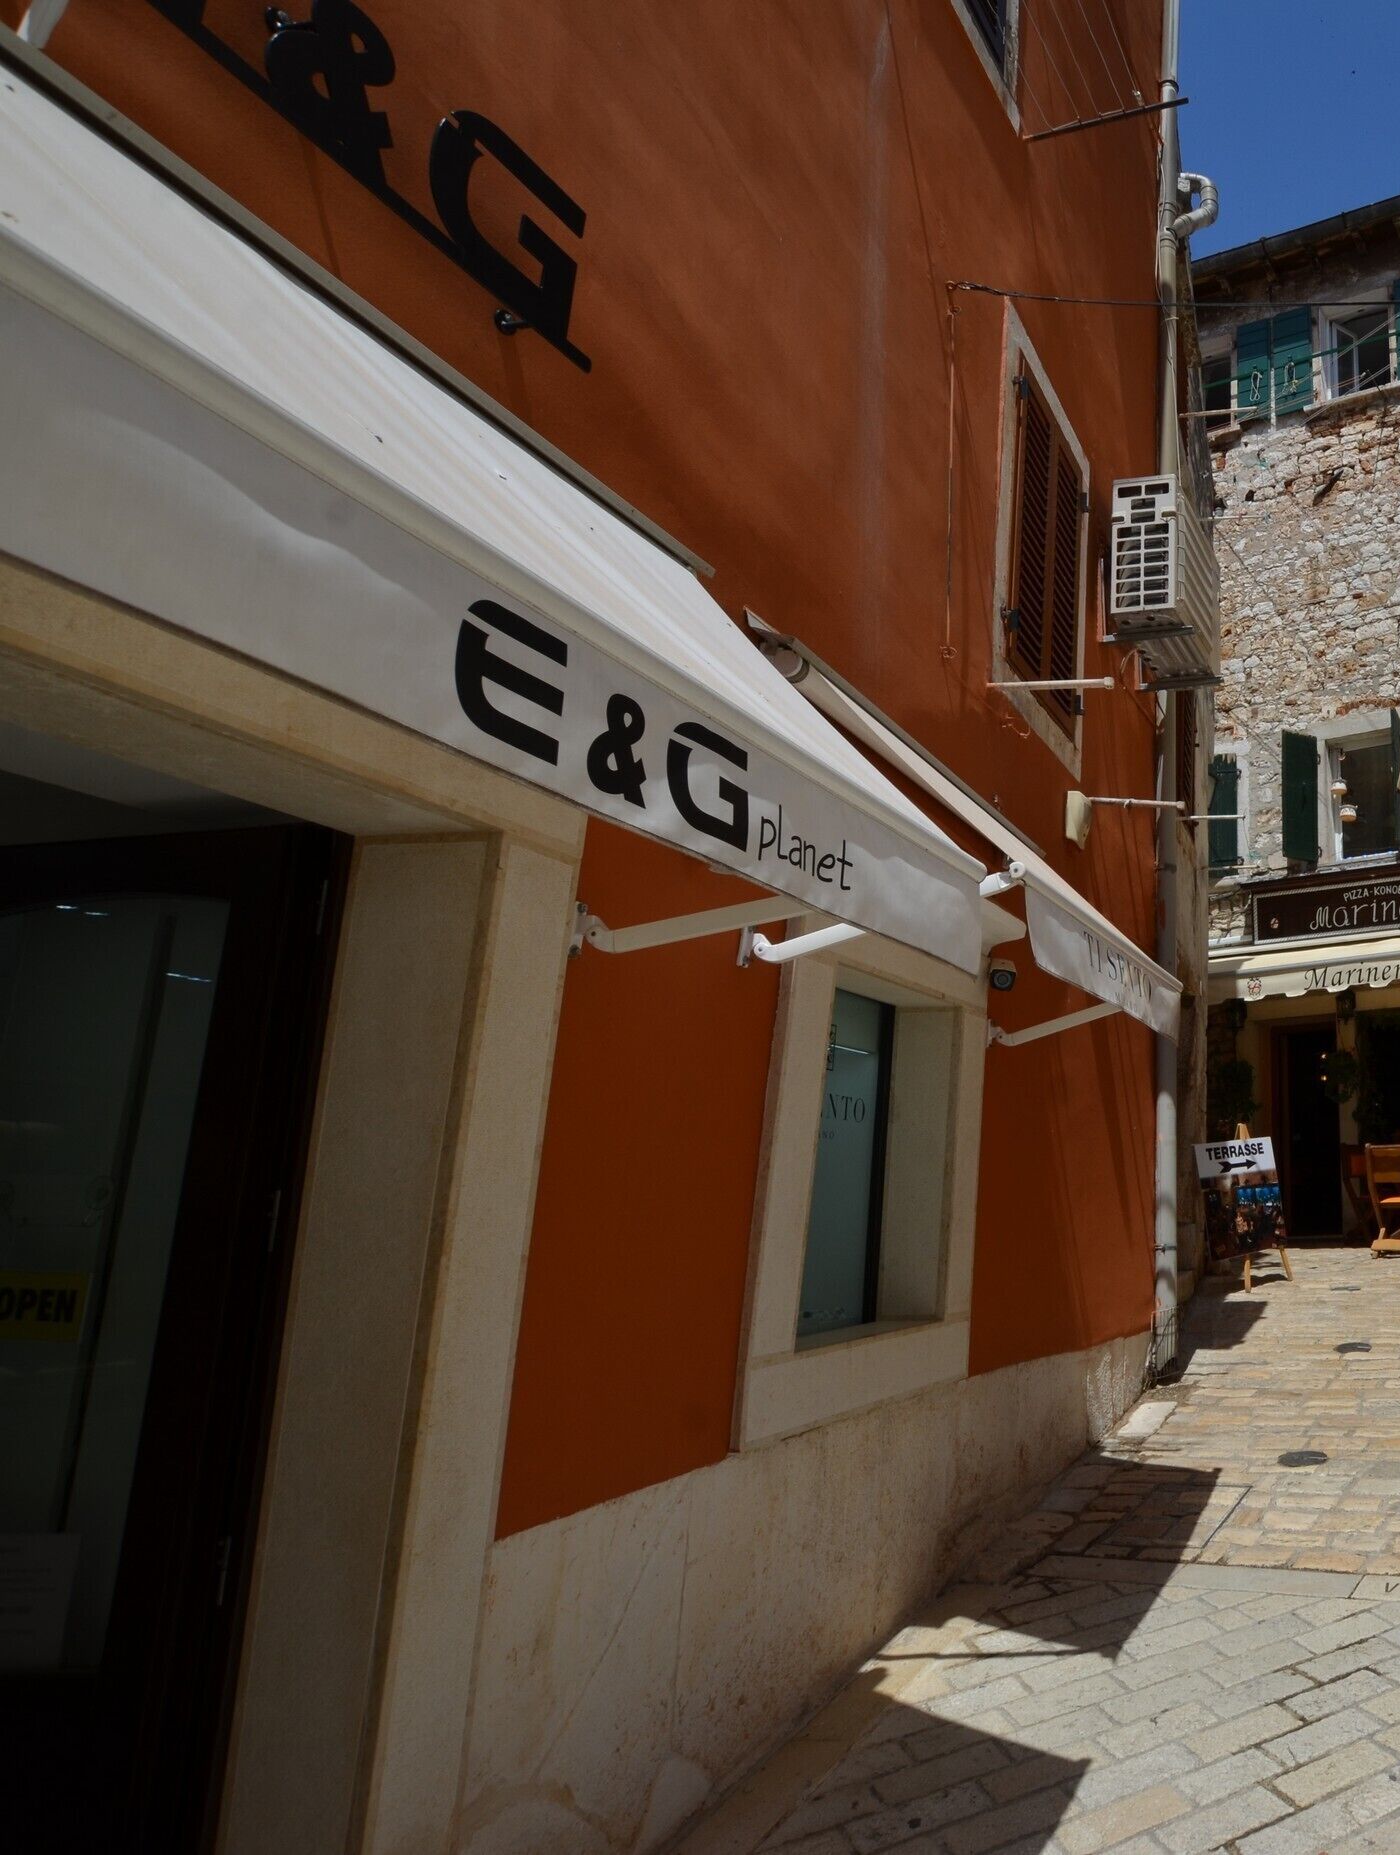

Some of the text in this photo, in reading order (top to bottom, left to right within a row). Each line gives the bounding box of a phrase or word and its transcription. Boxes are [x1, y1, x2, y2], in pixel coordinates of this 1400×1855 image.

[148, 0, 588, 350] &G
[758, 806, 853, 892] planet
[1083, 930, 1102, 973] TI
[822, 1092, 866, 1123] NTO
[1206, 1143, 1264, 1160] TERRASSE
